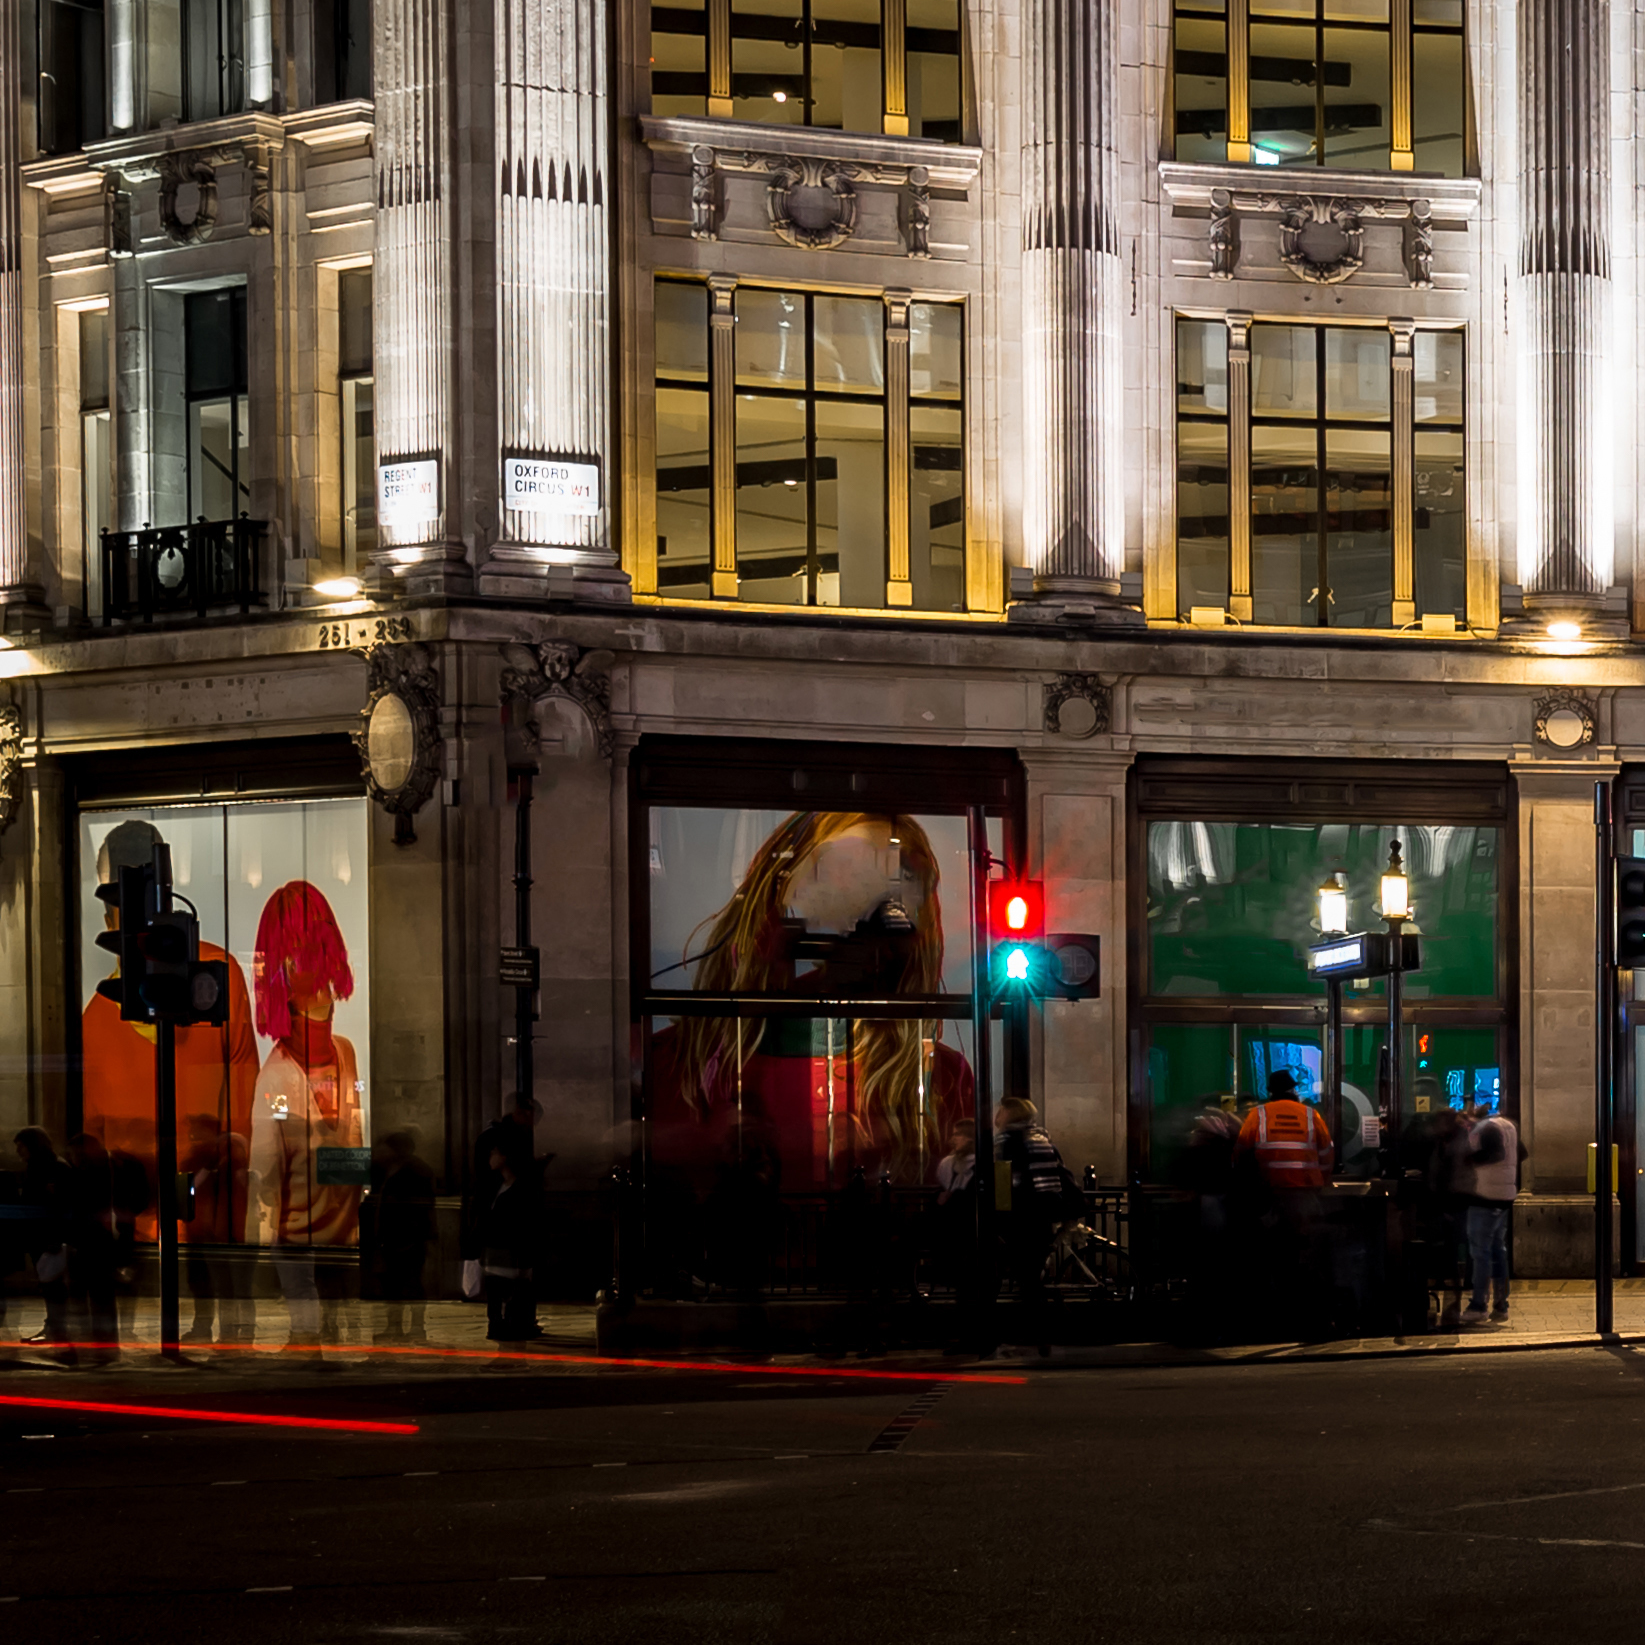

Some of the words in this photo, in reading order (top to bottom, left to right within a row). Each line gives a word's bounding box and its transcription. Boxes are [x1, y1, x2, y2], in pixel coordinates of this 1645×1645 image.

[384, 467, 417, 483] REGENT
[514, 463, 569, 480] OXFORD
[514, 479, 565, 495] CIRCUS
[570, 485, 590, 498] W1
[318, 1149, 344, 1160] UNITED
